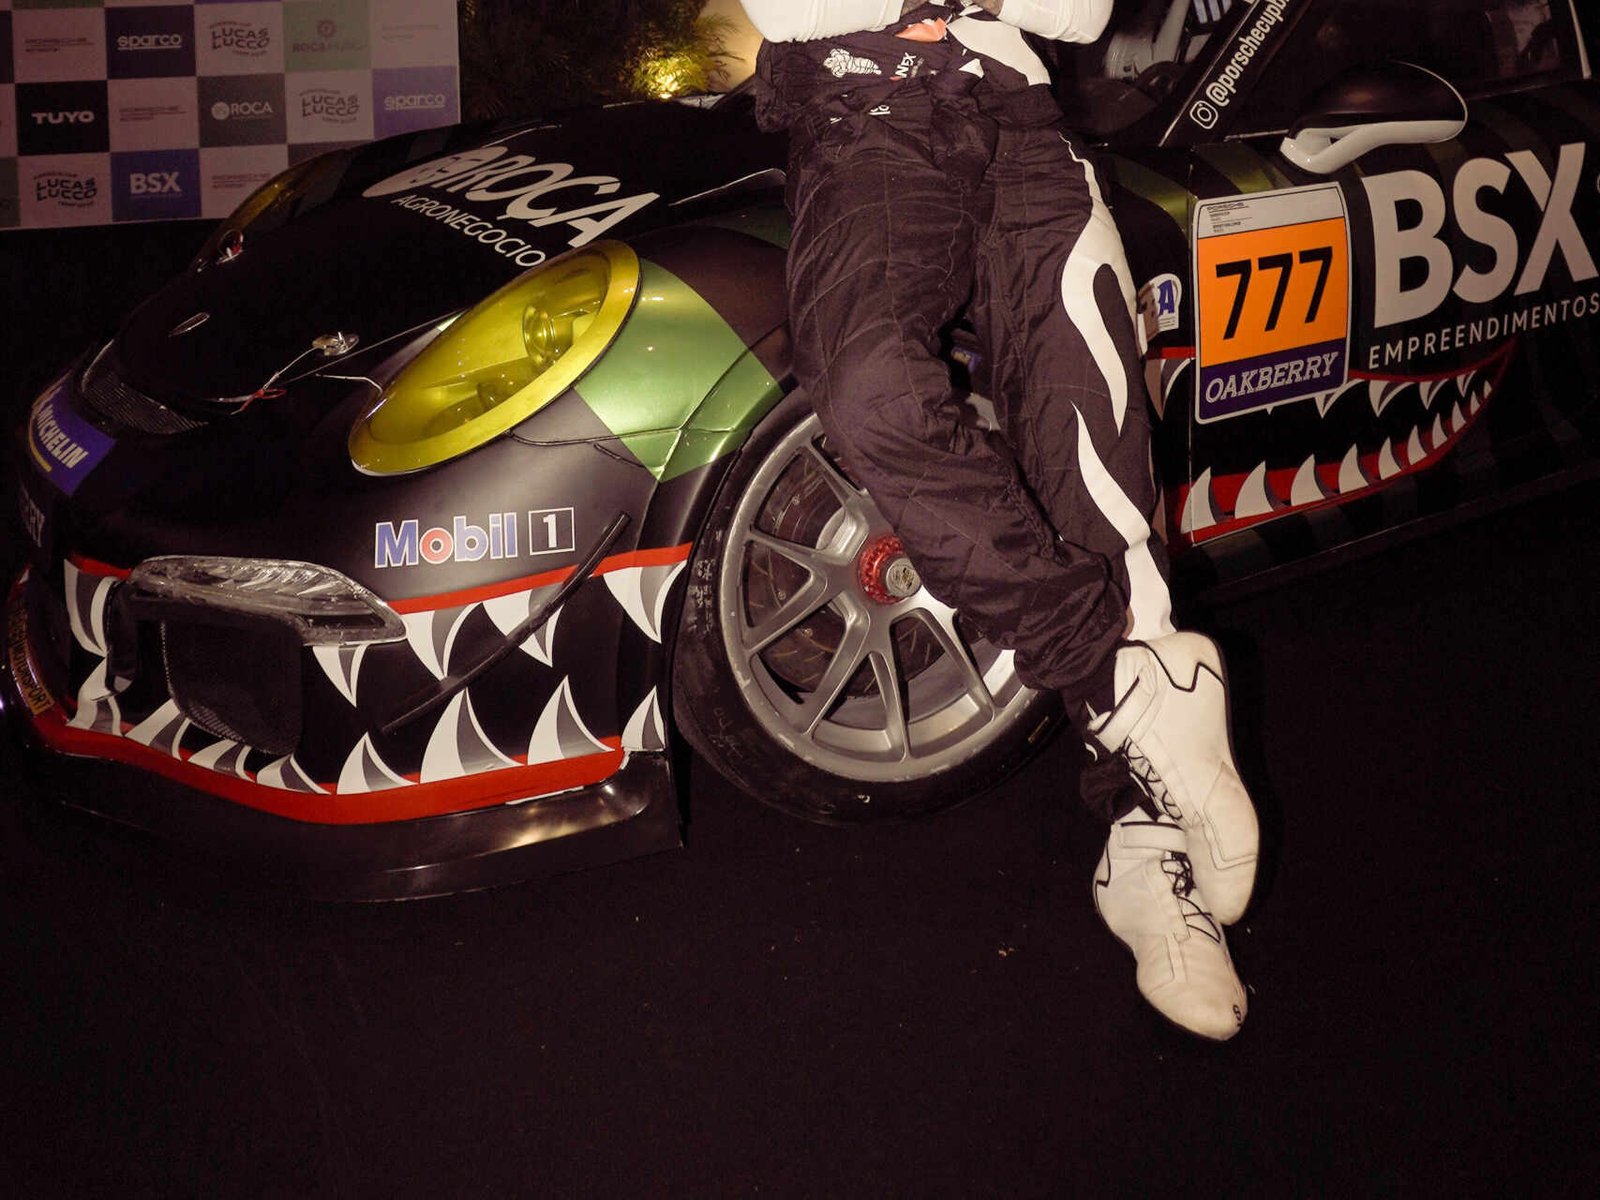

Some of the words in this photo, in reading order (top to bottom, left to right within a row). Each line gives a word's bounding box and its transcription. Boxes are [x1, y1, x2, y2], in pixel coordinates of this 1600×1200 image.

[117, 33, 182, 50] sparco
[212, 28, 269, 39] LUCAS
[212, 38, 270, 50] LUCCO
[231, 101, 273, 115] ROCA
[302, 95, 358, 107] LUCAS
[384, 93, 446, 111] sparco
[32, 110, 96, 125] TUYO
[302, 106, 359, 117] LUCCO
[37, 178, 96, 189] LUCAS
[129, 171, 183, 195] BSX
[37, 189, 97, 201] LUCCO
[431, 154, 661, 248] ROCA
[390, 194, 547, 267] AGRONEGOCIO
[1360, 142, 1600, 329] BSX
[1214, 246, 1333, 341] 777
[1368, 292, 1600, 370] EMPREENDIMENTOS
[1205, 352, 1339, 404] OAKBERRY
[36, 403, 90, 469] MICHELIN
[374, 511, 519, 569] Mobil
